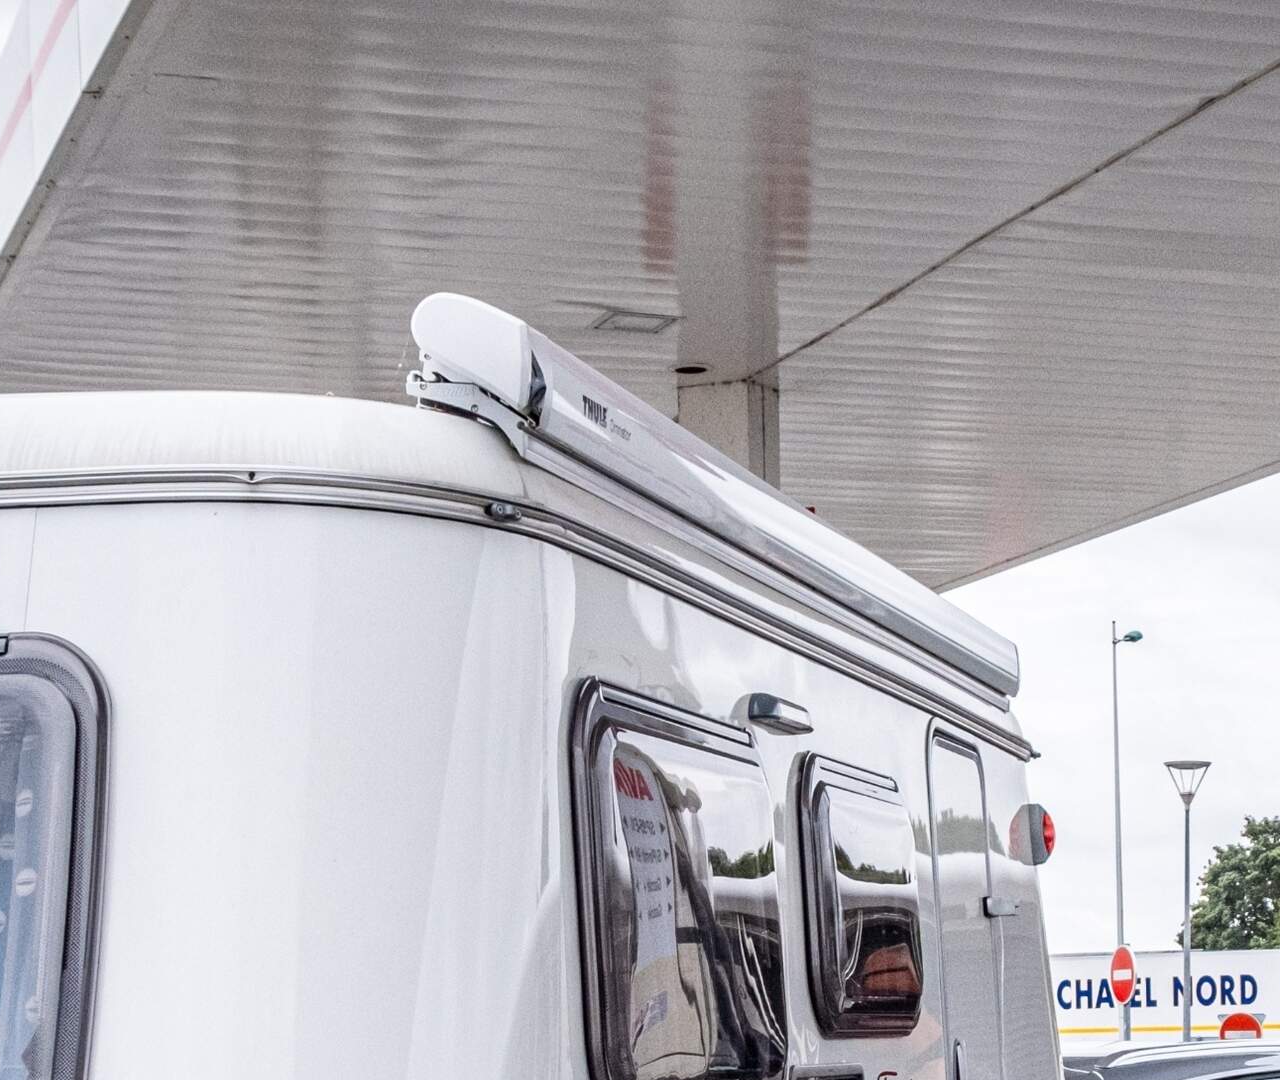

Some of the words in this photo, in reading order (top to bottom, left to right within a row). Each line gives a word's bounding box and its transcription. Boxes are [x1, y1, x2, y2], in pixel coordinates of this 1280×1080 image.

[582, 394, 608, 425] THULE
[1056, 976, 1158, 1010] CHAEL
[1172, 974, 1259, 1007] NORD
